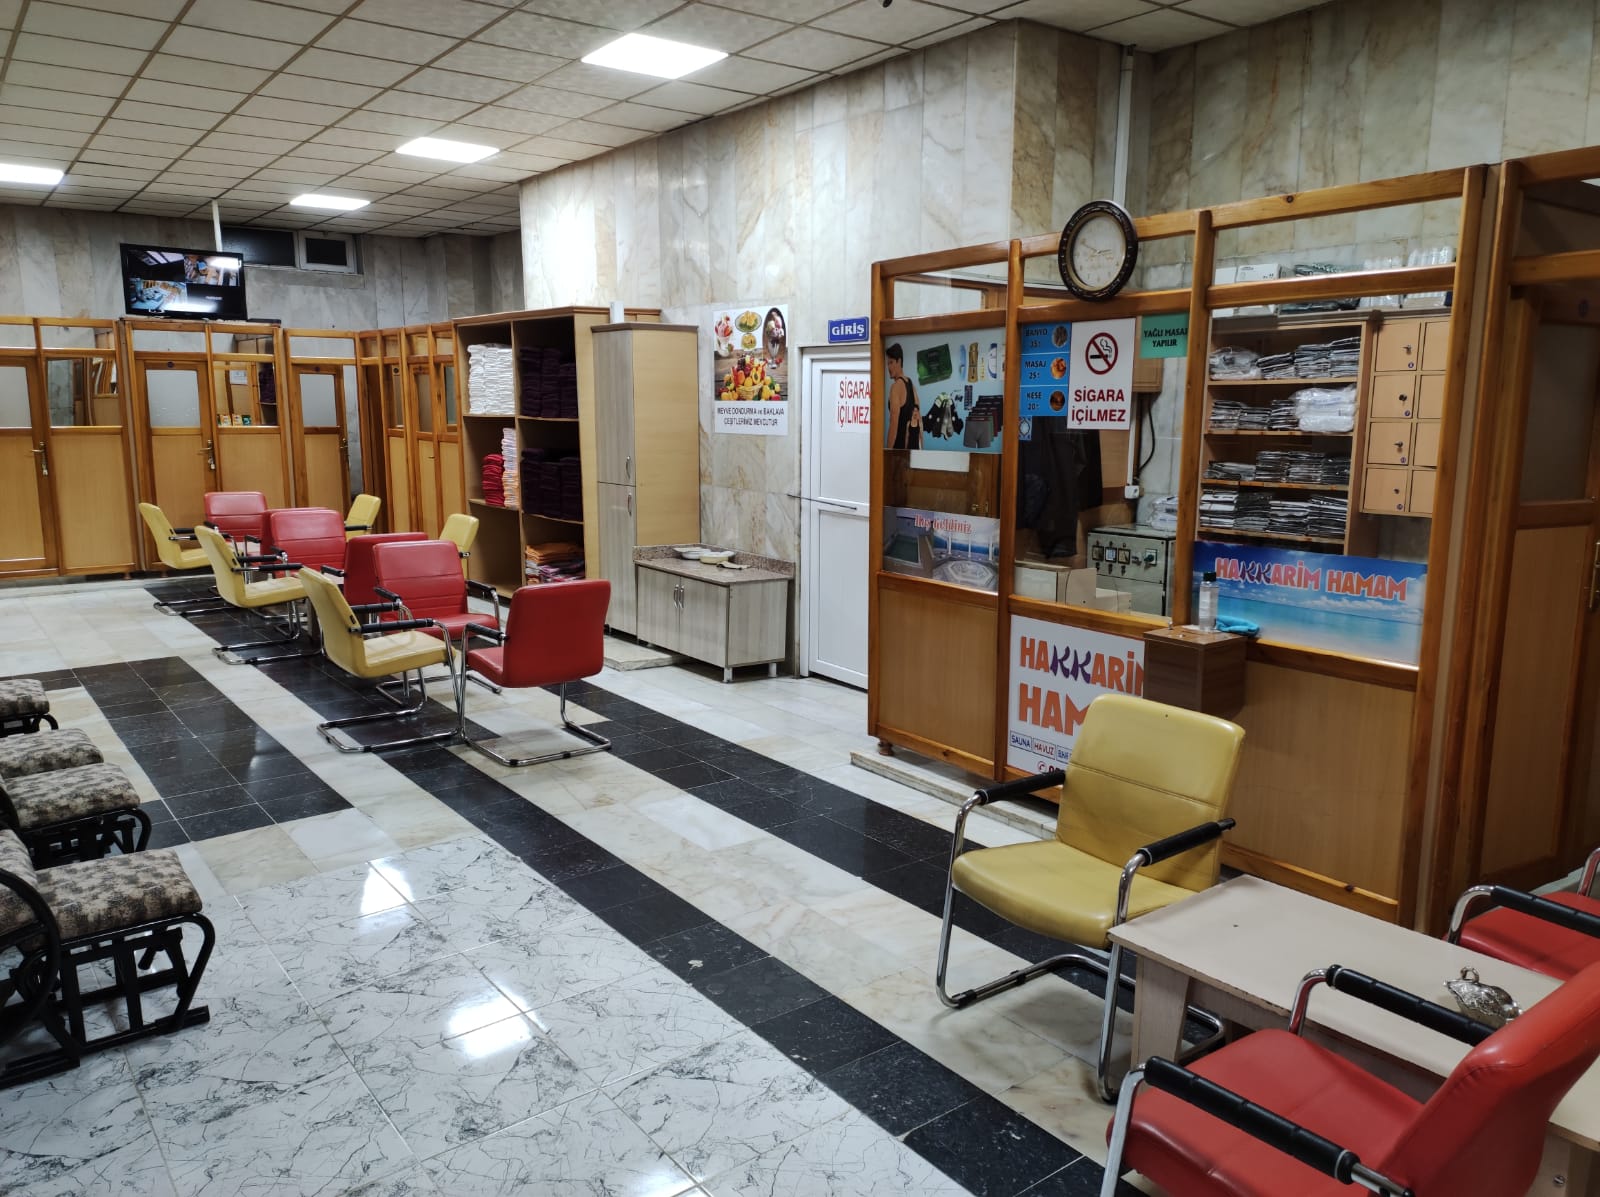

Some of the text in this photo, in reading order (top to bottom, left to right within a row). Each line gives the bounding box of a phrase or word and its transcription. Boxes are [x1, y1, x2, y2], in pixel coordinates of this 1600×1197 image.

[831, 322, 865, 337] GİRİŞ
[1143, 327, 1163, 338] YAĞLI
[1152, 338, 1178, 348] YAPILIR
[1025, 360, 1047, 368] MASAJ
[839, 377, 871, 399] SİGARA
[1074, 386, 1125, 402] SİGARA
[763, 407, 785, 416] BAKLAVA
[837, 401, 870, 428] İÇİLMEZ
[1071, 405, 1126, 425] İÇİLMEZ
[1215, 557, 1407, 601] HAKKARİM HAMAM
[1011, 734, 1031, 748] SAUNA
[1034, 742, 1054, 756] HAVUZ
